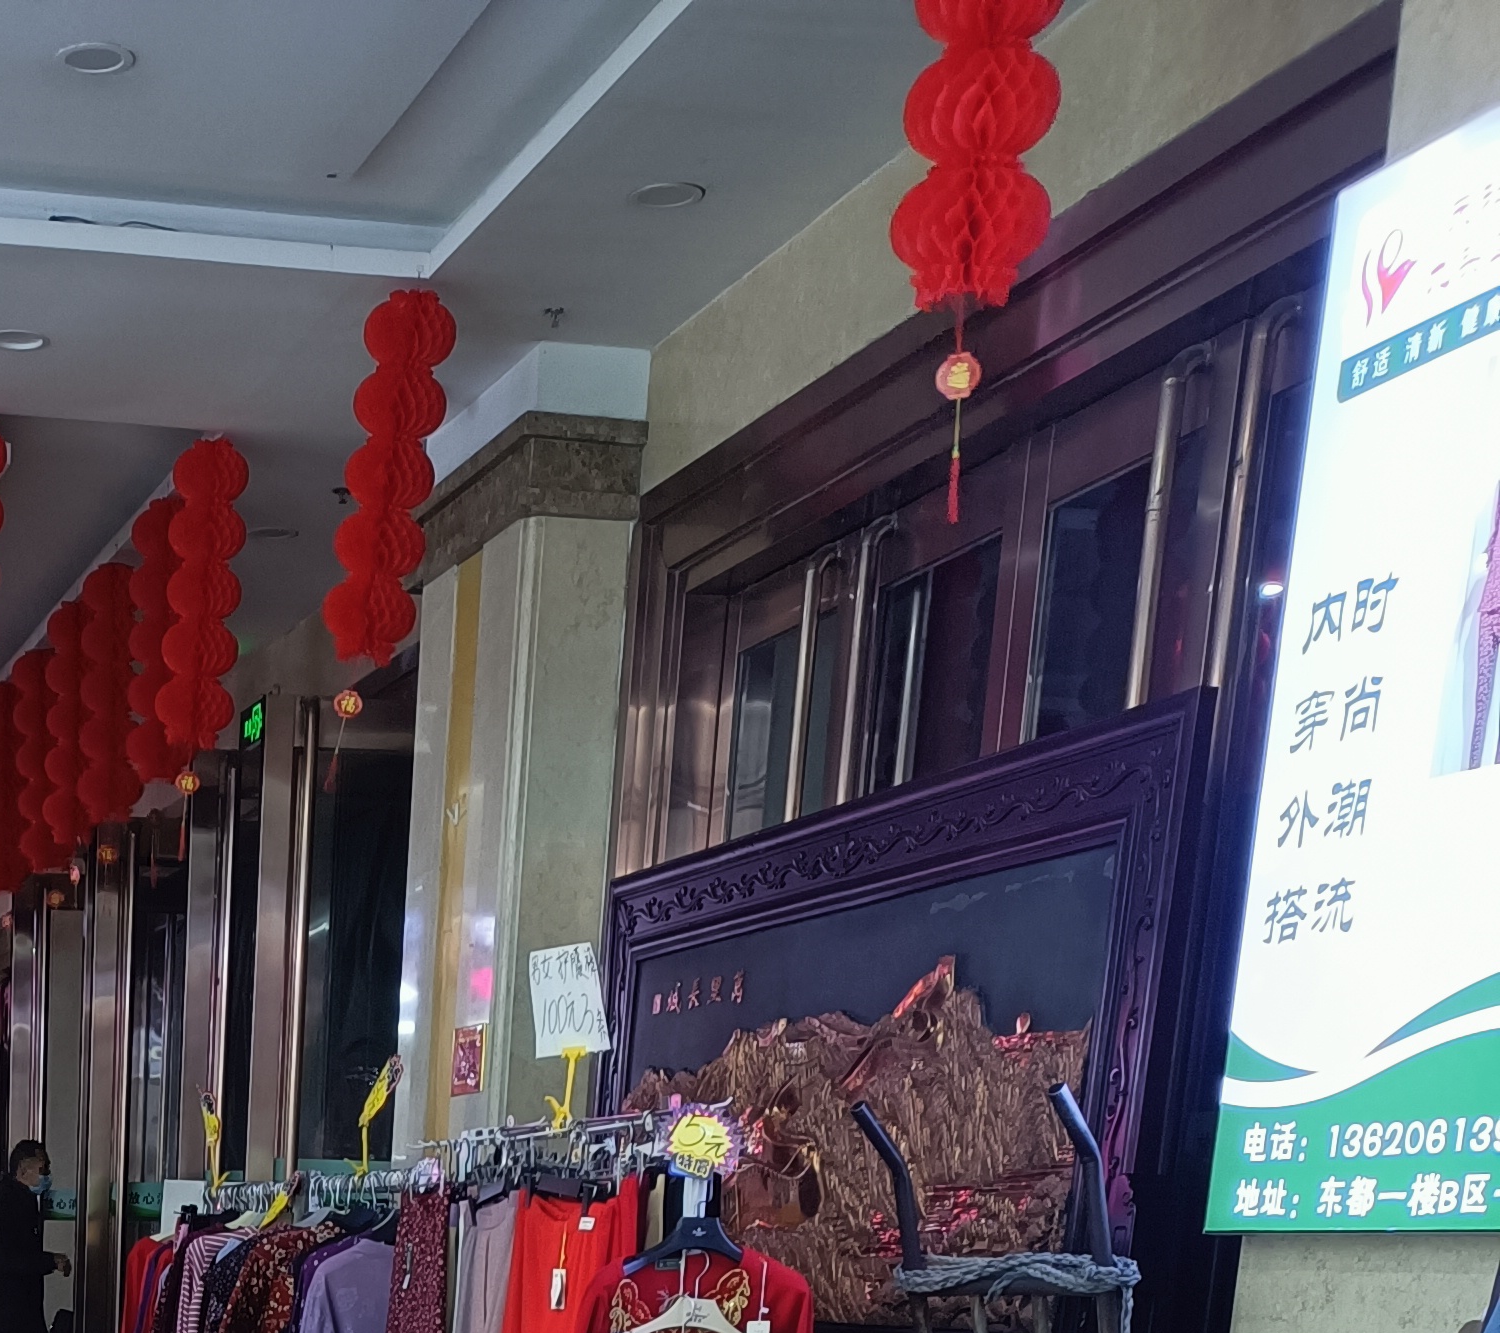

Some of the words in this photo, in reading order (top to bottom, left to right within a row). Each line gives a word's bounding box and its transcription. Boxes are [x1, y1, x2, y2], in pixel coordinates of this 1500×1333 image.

[1351, 346, 1390, 389] 舒适
[1262, 588, 1345, 946] 内穿外搭
[1310, 571, 1399, 935] 时尚潮流
[1316, 1172, 1500, 1218] 东都一楼B区
